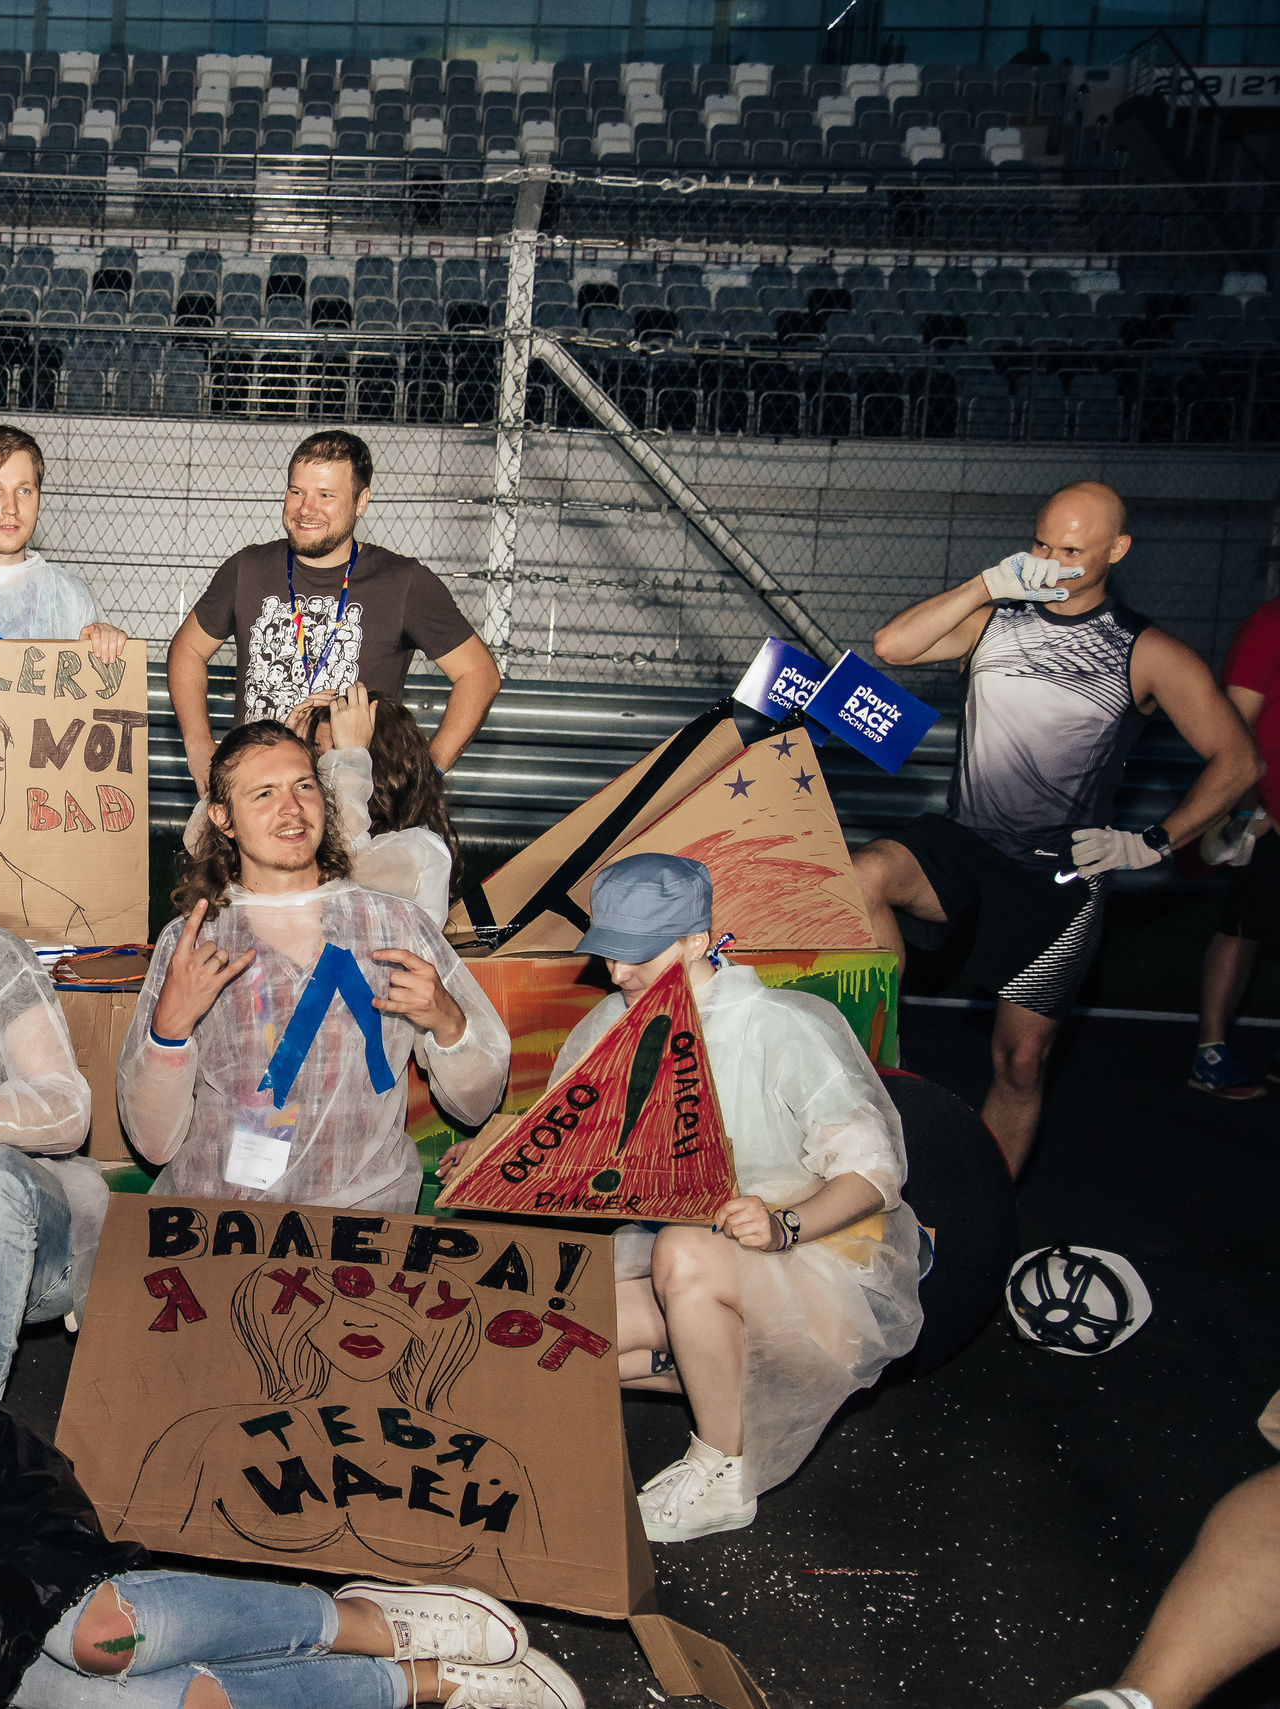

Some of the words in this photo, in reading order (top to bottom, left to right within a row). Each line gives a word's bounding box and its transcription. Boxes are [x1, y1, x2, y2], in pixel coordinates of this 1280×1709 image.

[1241, 75, 1280, 95] 21
[771, 677, 809, 705] RAC
[779, 666, 821, 692] playri
[767, 692, 792, 710] SOCHI
[844, 695, 894, 737] RACE
[853, 685, 902, 722] playrix
[29, 709, 148, 774] NOT
[838, 709, 864, 731] SOCHI
[863, 727, 883, 744] 2019
[27, 784, 135, 833] BAD
[501, 1084, 600, 1183] ОСОБО
[535, 1191, 643, 1214] DANGER
[148, 1207, 592, 1312] ВАЛЕРА!
[143, 1266, 207, 1332] Я
[264, 1266, 472, 1320] ХОЧУ
[485, 1310, 612, 1371] ОТ
[238, 1405, 489, 1472] ТЕБЯ
[241, 1454, 520, 1532] ИДЕЙ
